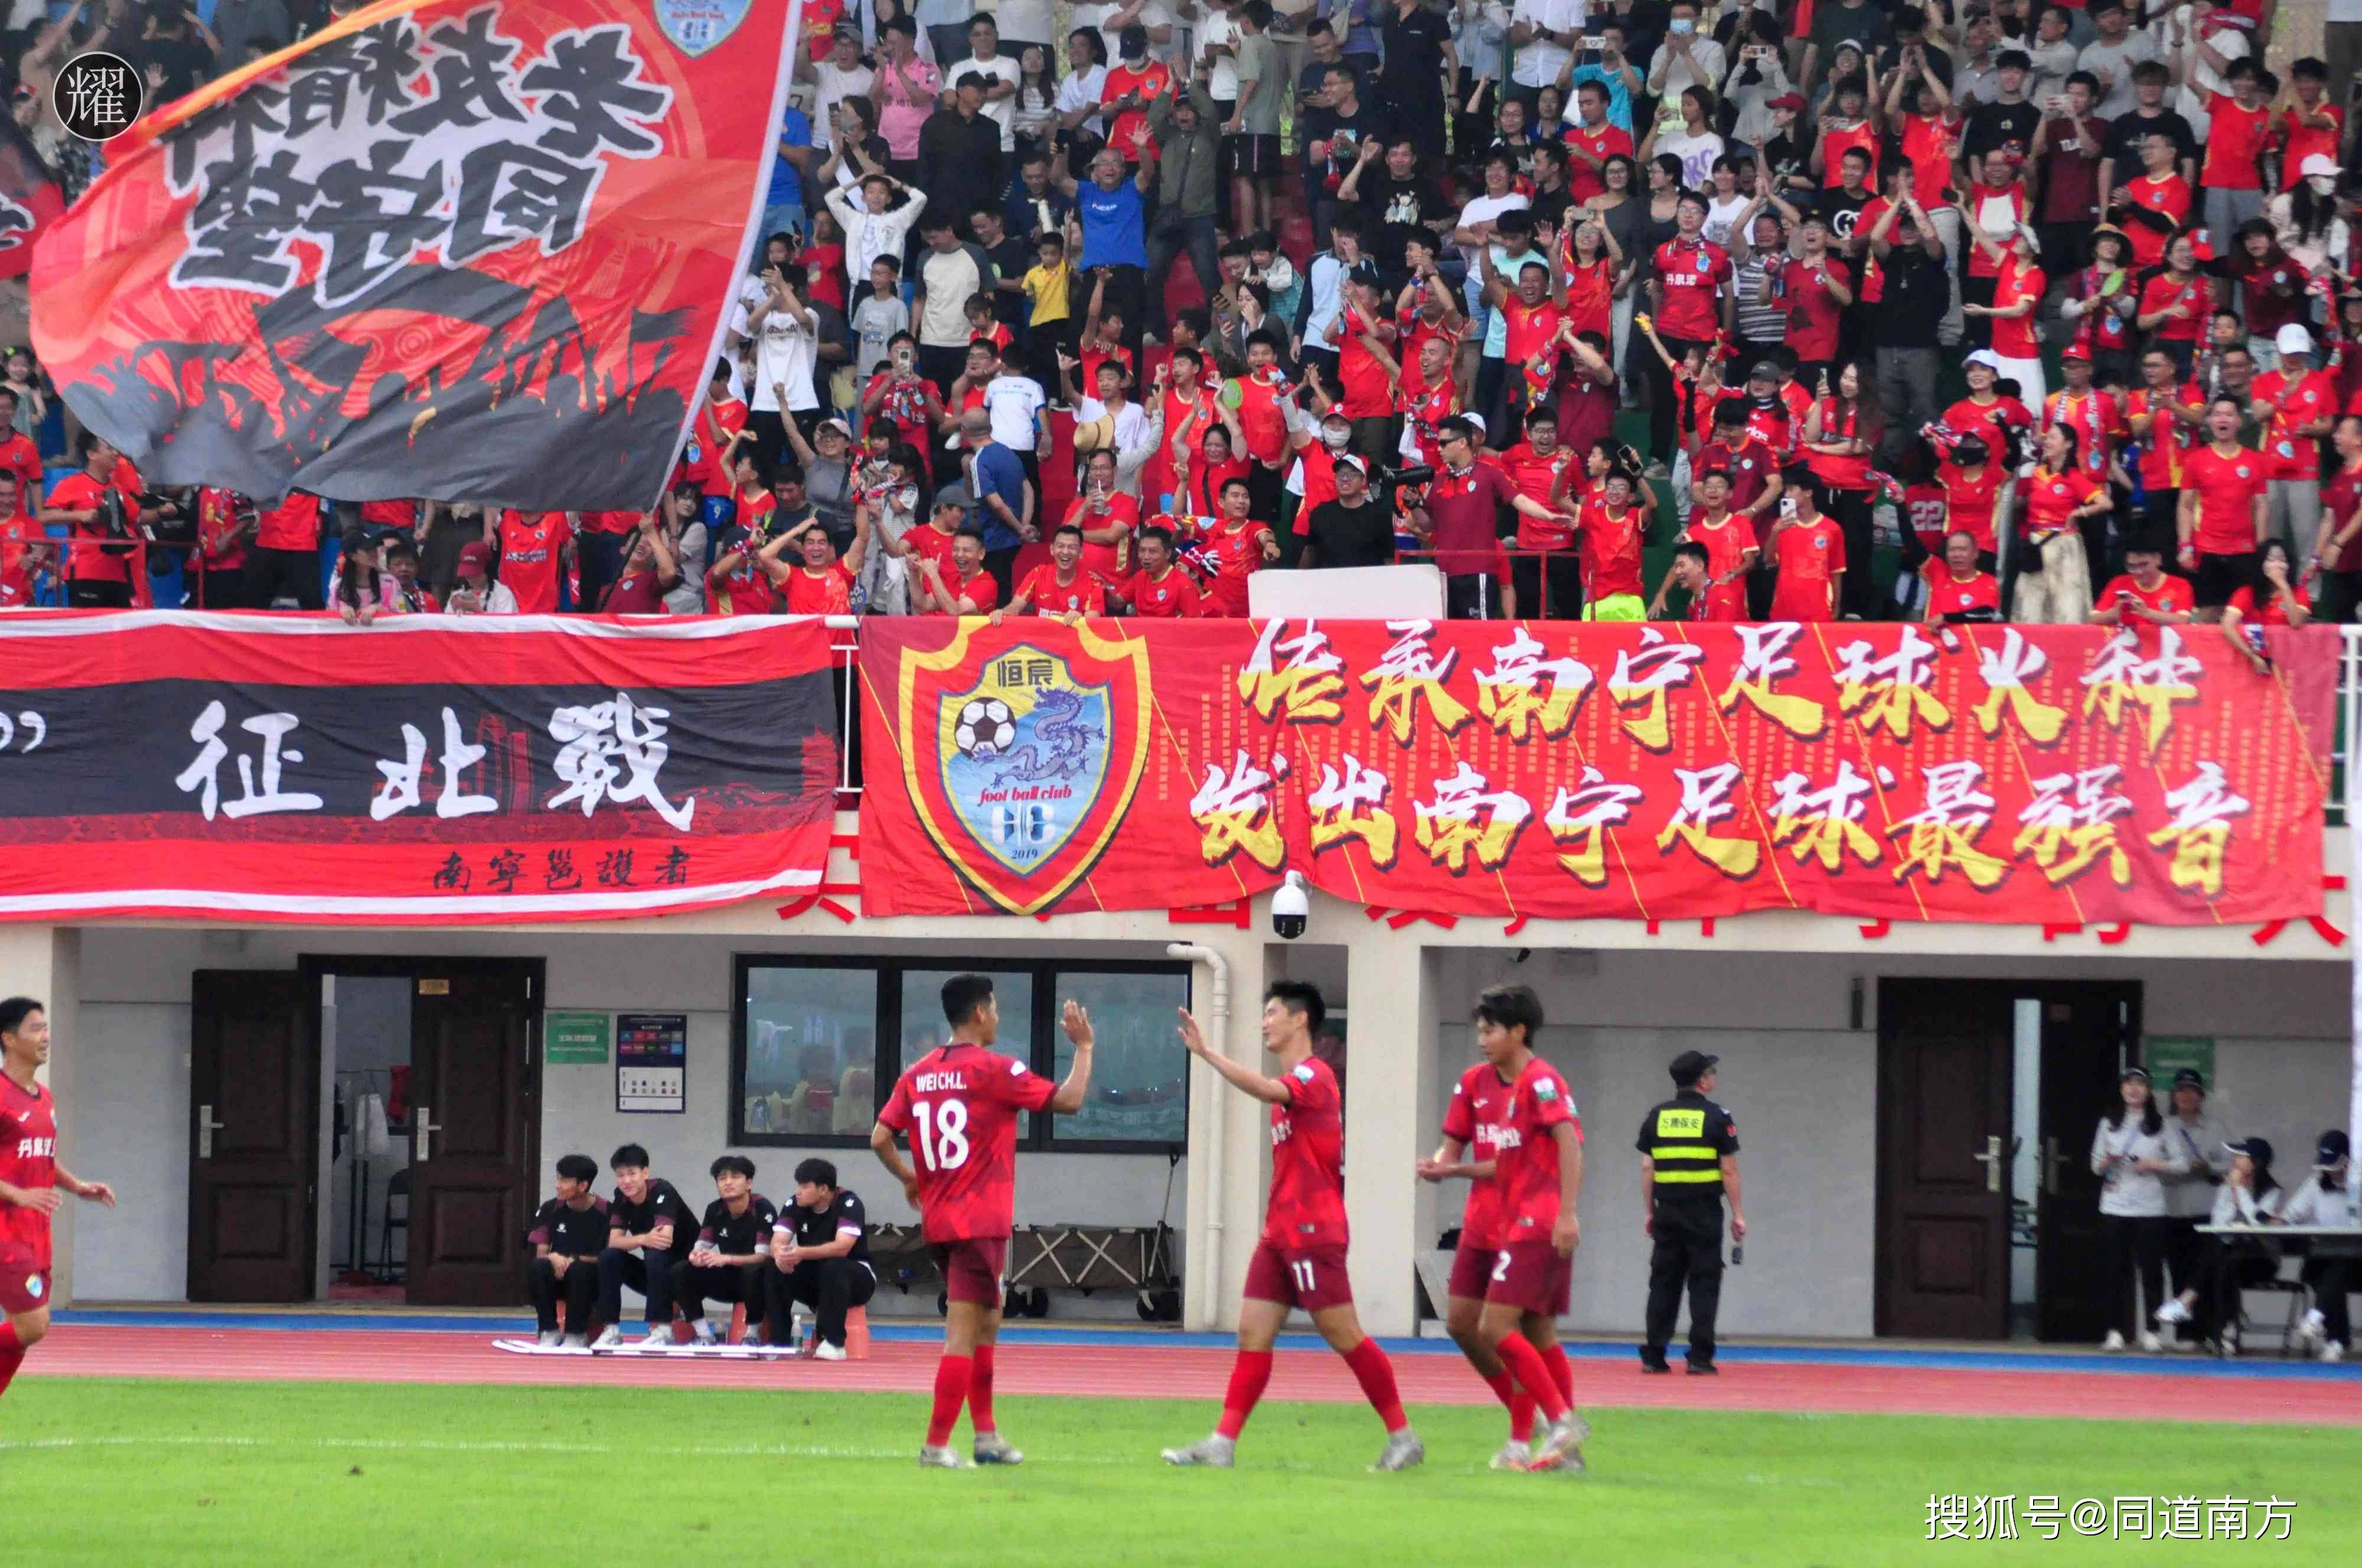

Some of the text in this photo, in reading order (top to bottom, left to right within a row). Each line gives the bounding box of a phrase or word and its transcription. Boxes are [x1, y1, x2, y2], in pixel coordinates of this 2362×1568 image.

[1910, 501, 1945, 531] 22
[1237, 618, 2203, 754] 传承南宁足球火种
[1190, 749, 2251, 900] 发出南宁足球最强音
[1011, 848, 1038, 860] 2019
[912, 1099, 969, 1172] 18
[1291, 1261, 1316, 1292] 11
[1492, 1252, 1512, 1282] 2
